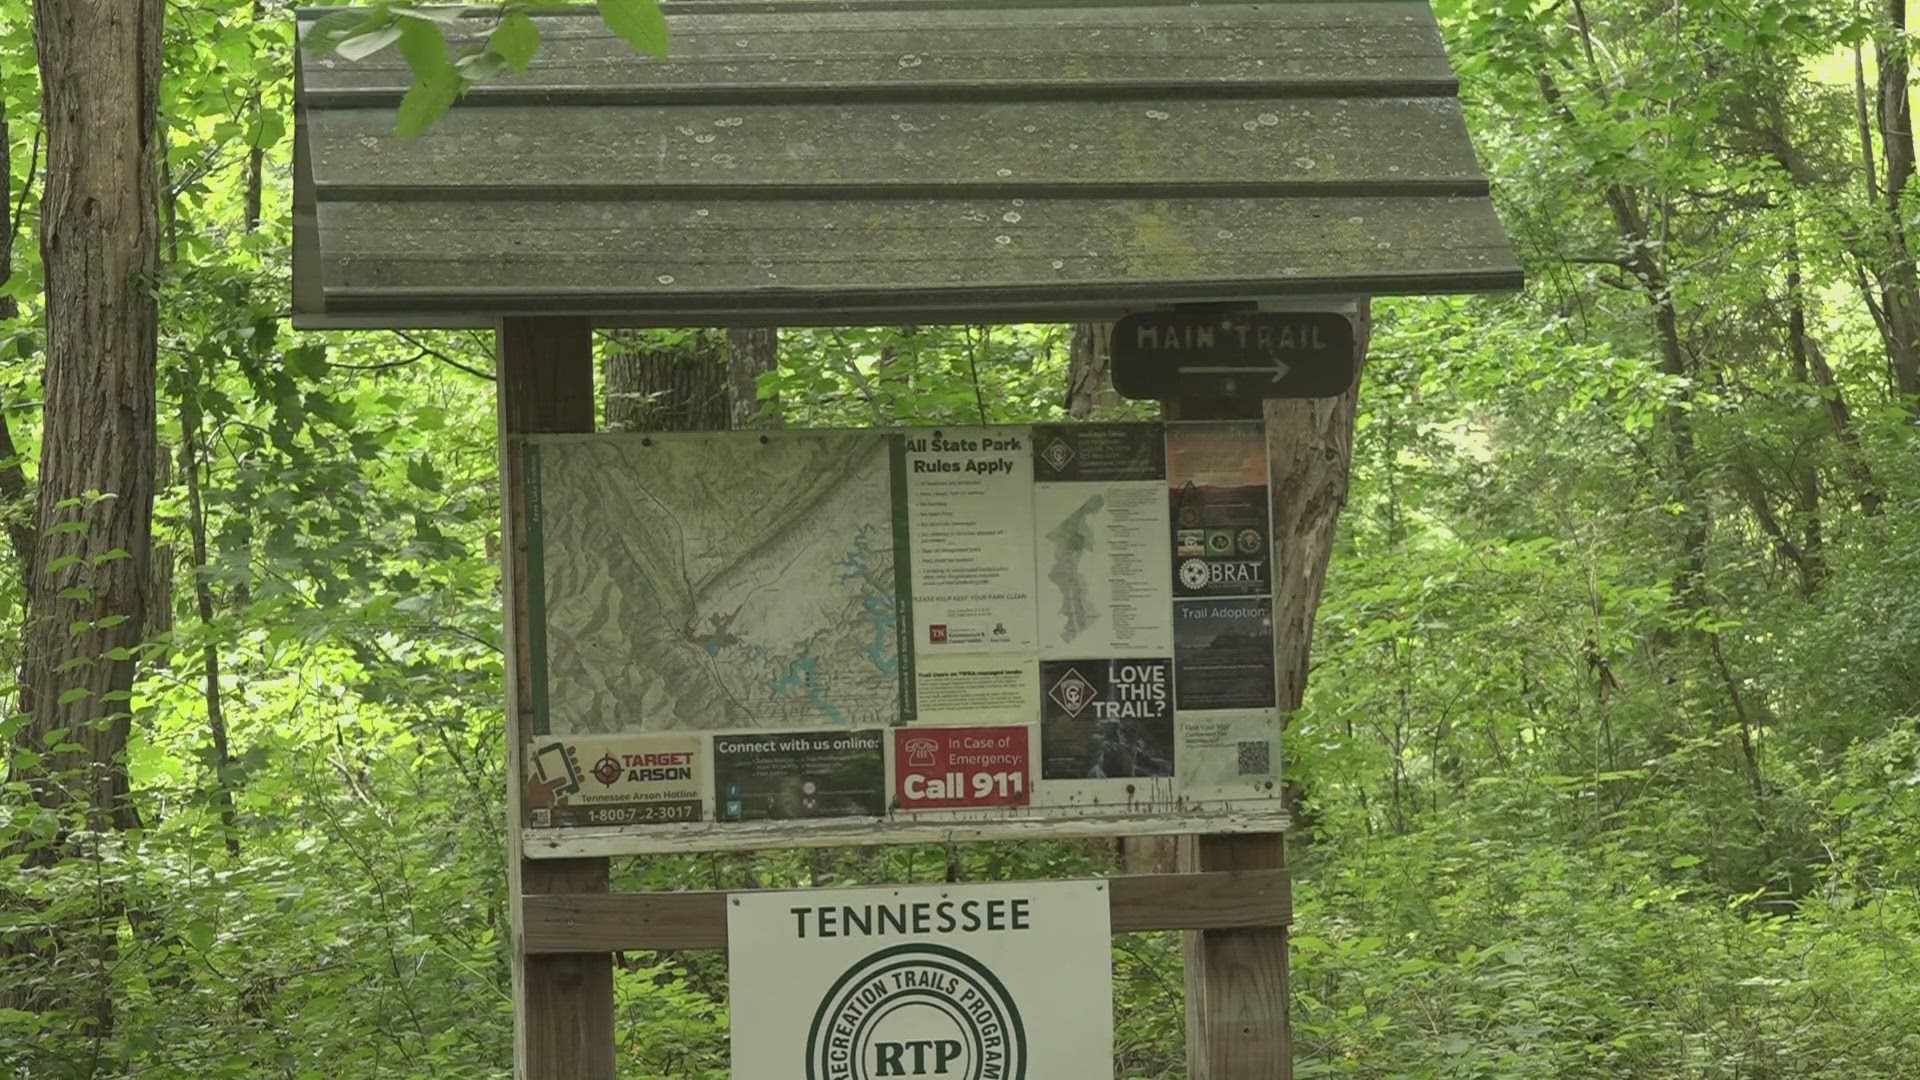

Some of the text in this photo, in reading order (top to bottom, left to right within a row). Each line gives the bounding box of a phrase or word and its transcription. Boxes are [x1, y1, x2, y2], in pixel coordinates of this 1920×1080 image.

[1136, 325, 1327, 349] MAIN TRAIL
[906, 437, 1022, 452] All State Park
[914, 458, 1014, 475] Rules Apply
[1211, 562, 1263, 582] BRAT
[1181, 606, 1265, 621] Trail Adoption
[931, 629, 946, 638] TN
[1108, 665, 1165, 683] LOVE
[1116, 683, 1166, 700] THIS
[1092, 701, 1166, 718] TRAIL?
[719, 736, 879, 754] Connect with us online:
[948, 736, 1011, 749] In Case of
[622, 752, 694, 768] TARGET
[949, 753, 1023, 767] Emergency:
[627, 767, 691, 782] ARSON
[903, 771, 1023, 800] Call 911
[582, 789, 698, 803] Tennessee Arson Hotline
[588, 805, 693, 822] 1-800-72-3017
[790, 899, 1030, 938] TENNESSEE
[891, 970, 960, 995] TRAILS
[959, 988, 1003, 1080] PROGRAM
[874, 1039, 963, 1077] RTP
